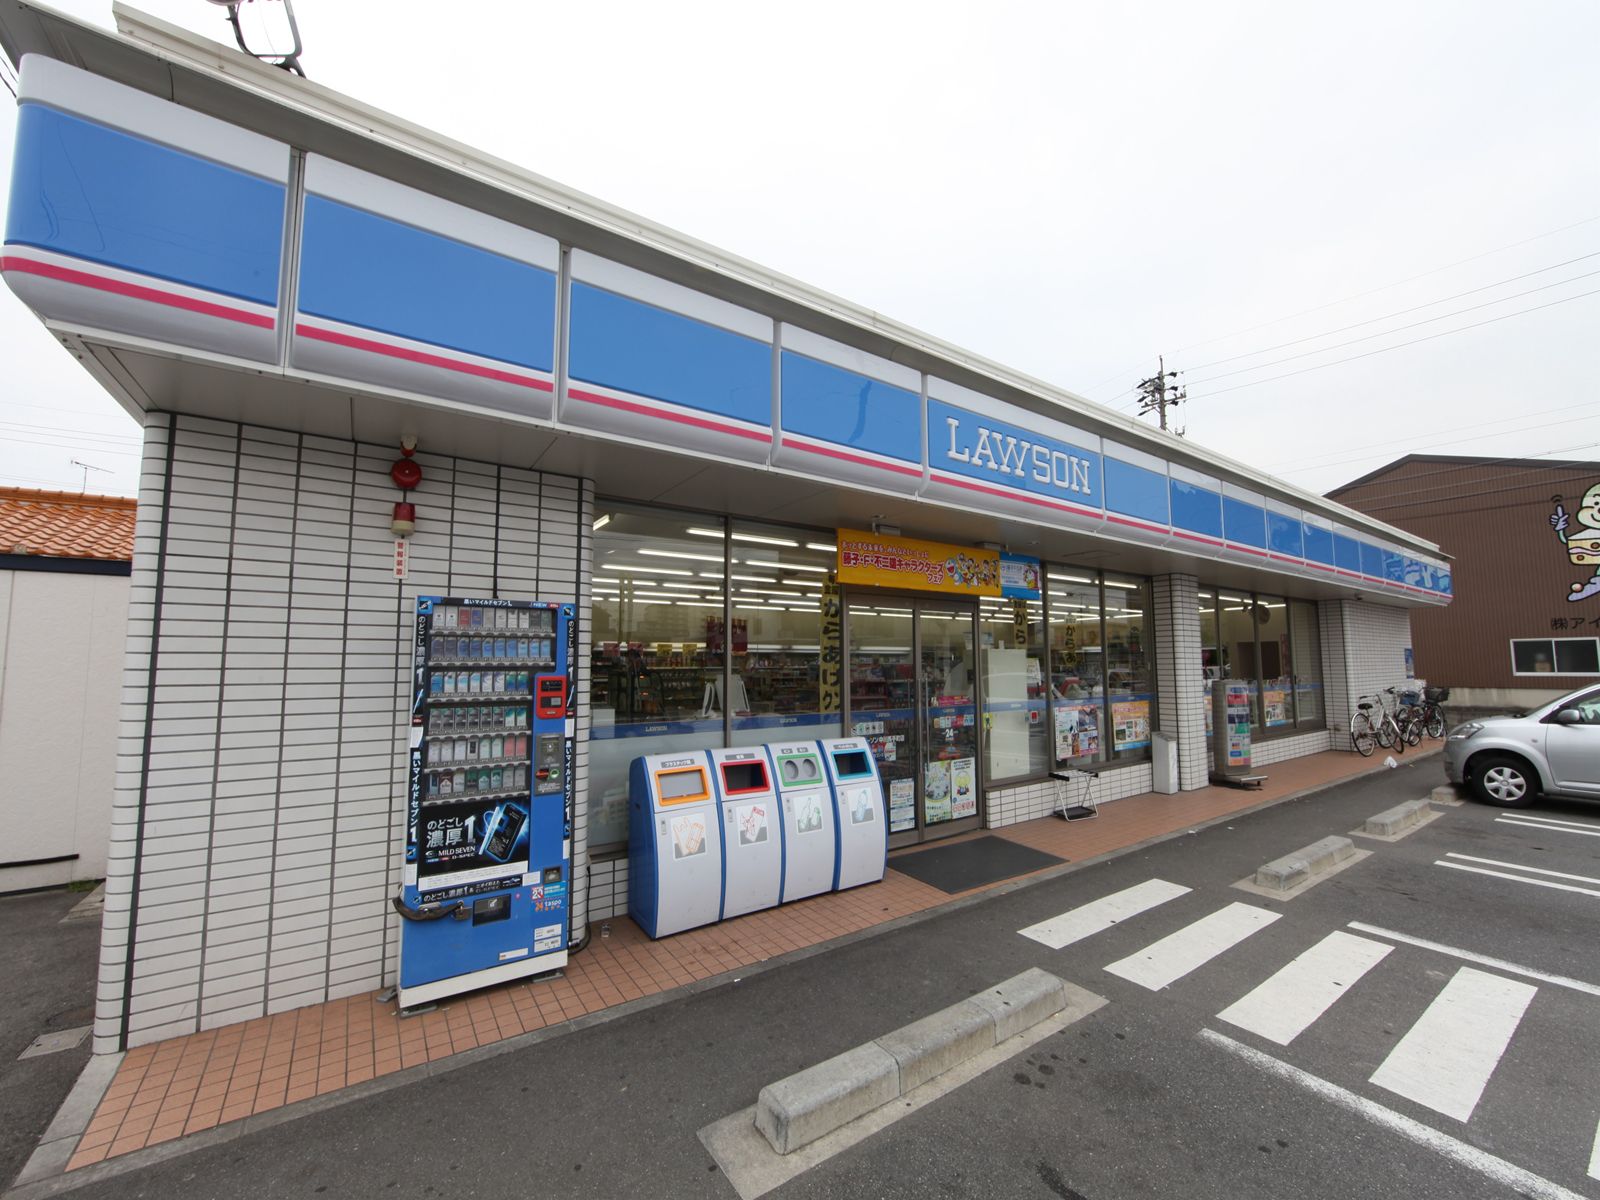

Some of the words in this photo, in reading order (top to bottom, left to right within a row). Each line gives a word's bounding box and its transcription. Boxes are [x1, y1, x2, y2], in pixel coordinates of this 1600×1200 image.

[947, 417, 1092, 494] LAWSON
[945, 728, 954, 737] 24
[427, 817, 463, 830] のどごし
[426, 828, 463, 848] 濃厚
[438, 849, 455, 857] MILD
[456, 846, 475, 854] SEVEN
